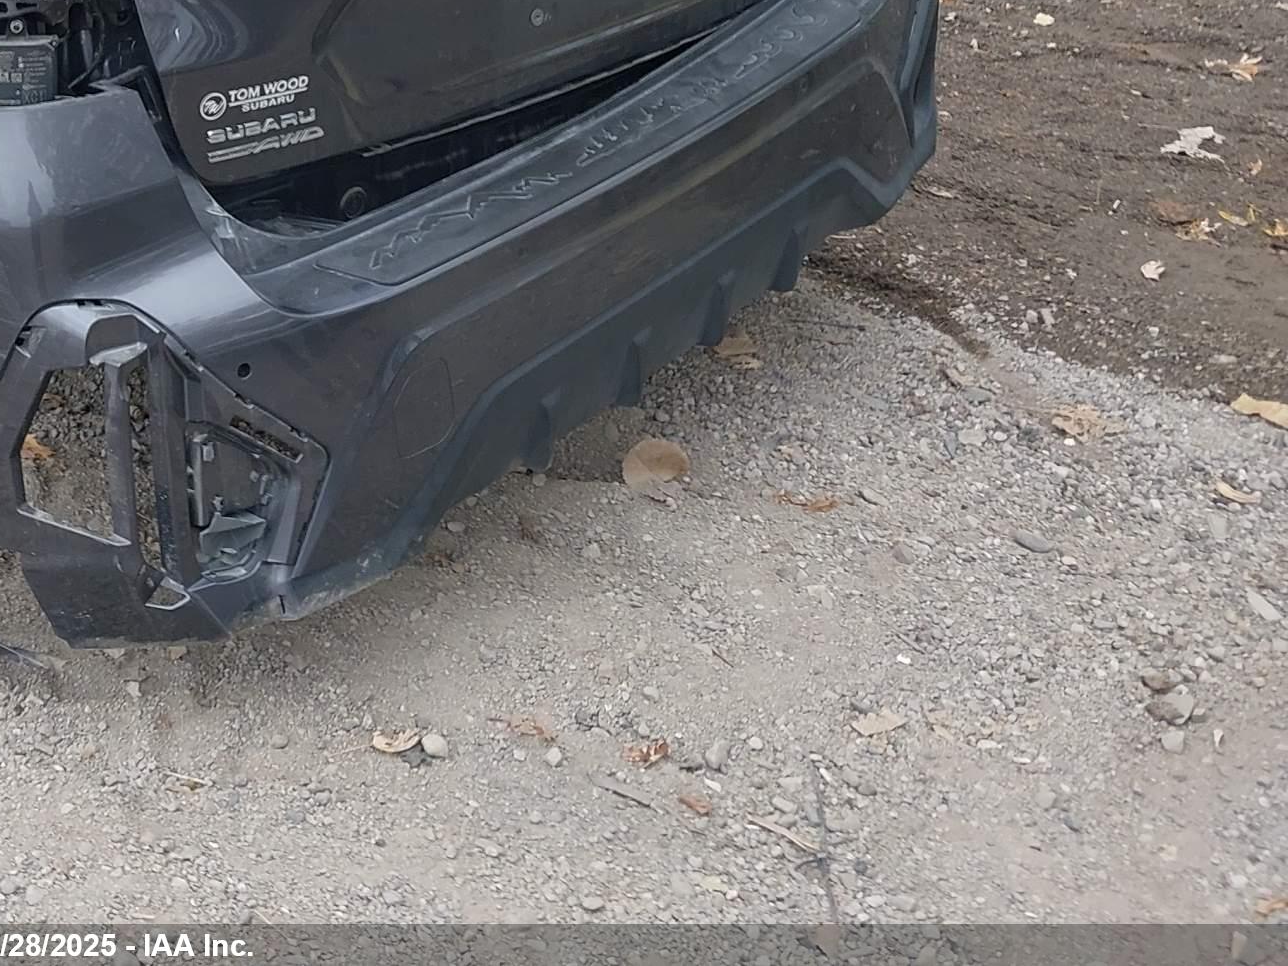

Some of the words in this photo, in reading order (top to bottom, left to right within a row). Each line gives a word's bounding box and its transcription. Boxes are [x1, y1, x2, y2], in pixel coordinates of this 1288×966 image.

[228, 84, 261, 103] TOM
[263, 75, 309, 95] WOOD
[241, 94, 295, 113] SUBARU
[207, 107, 316, 144] SUBARU
